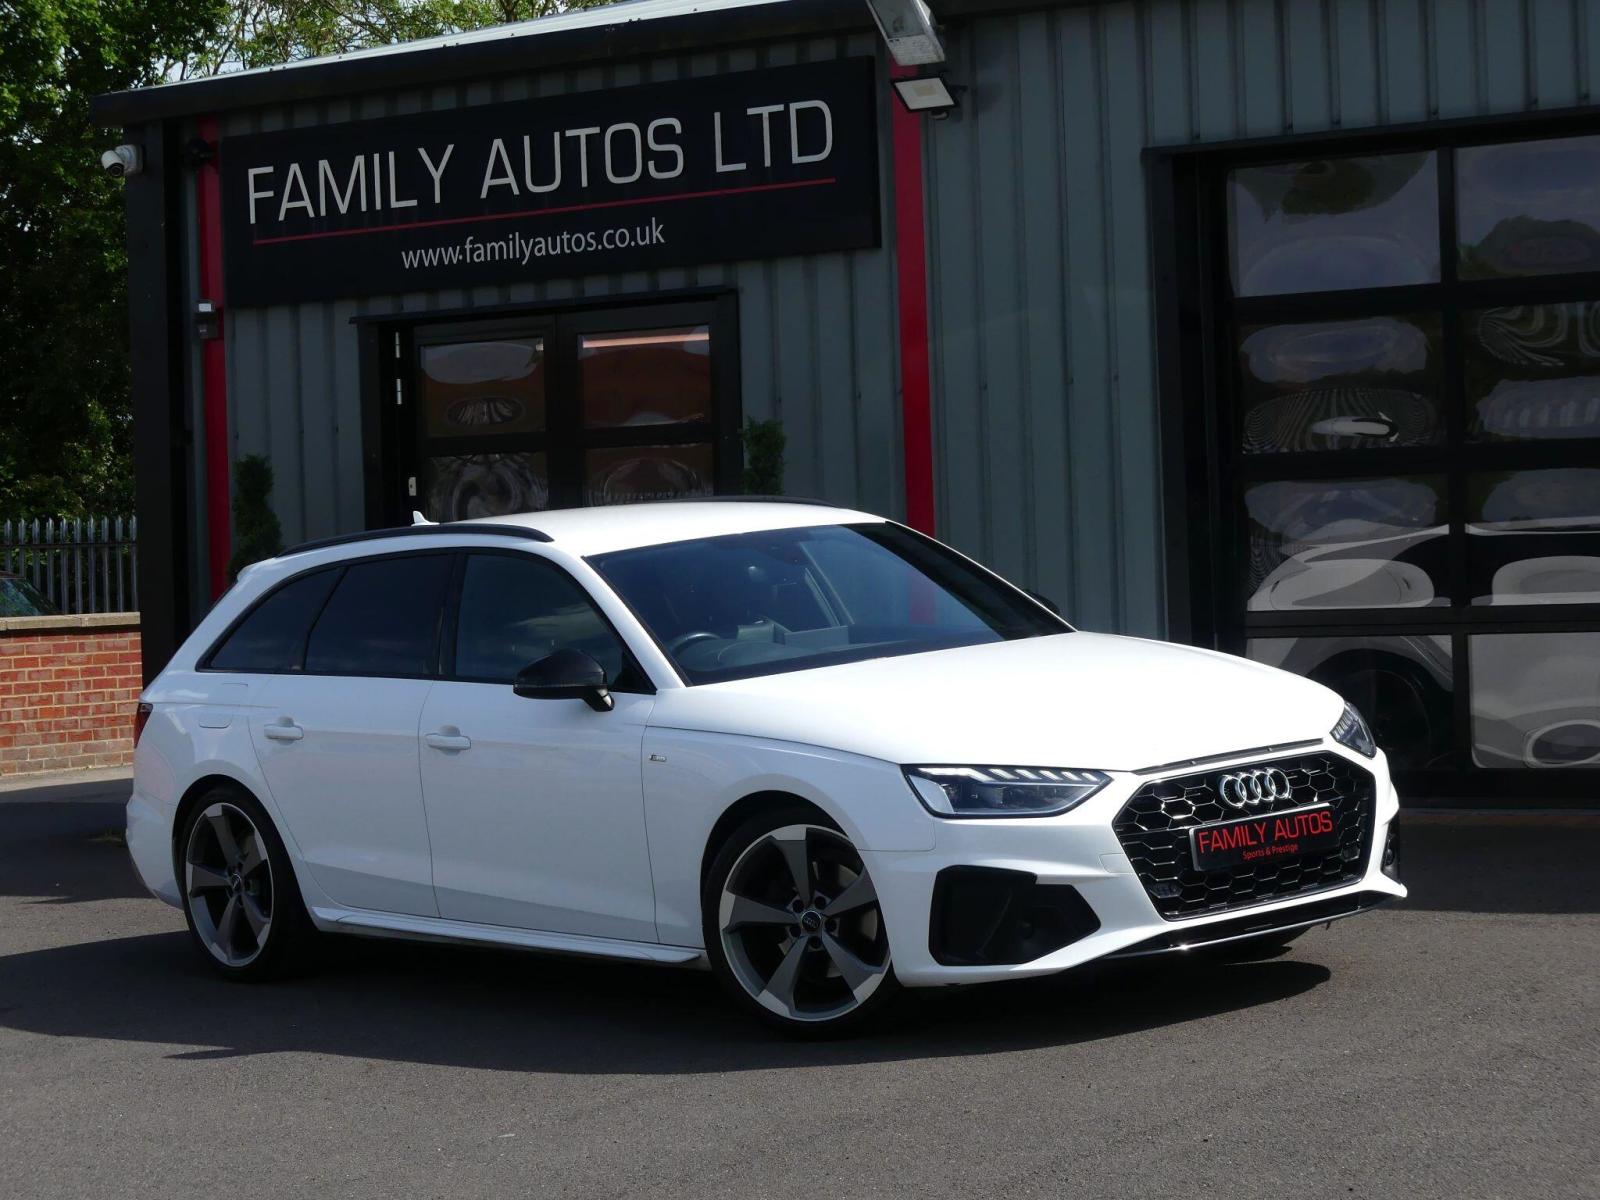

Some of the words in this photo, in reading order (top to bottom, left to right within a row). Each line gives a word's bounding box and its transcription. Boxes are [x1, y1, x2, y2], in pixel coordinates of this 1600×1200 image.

[247, 143, 455, 225] FAMILY
[480, 117, 685, 199] AUTOS
[713, 98, 834, 174] LTD
[401, 217, 666, 269] www.familyautos.co.uk
[1198, 822, 1267, 854] FAMILY
[1274, 811, 1333, 841] AUTOS
[1242, 849, 1265, 860] Sports
[1271, 843, 1298, 855] Prestige
